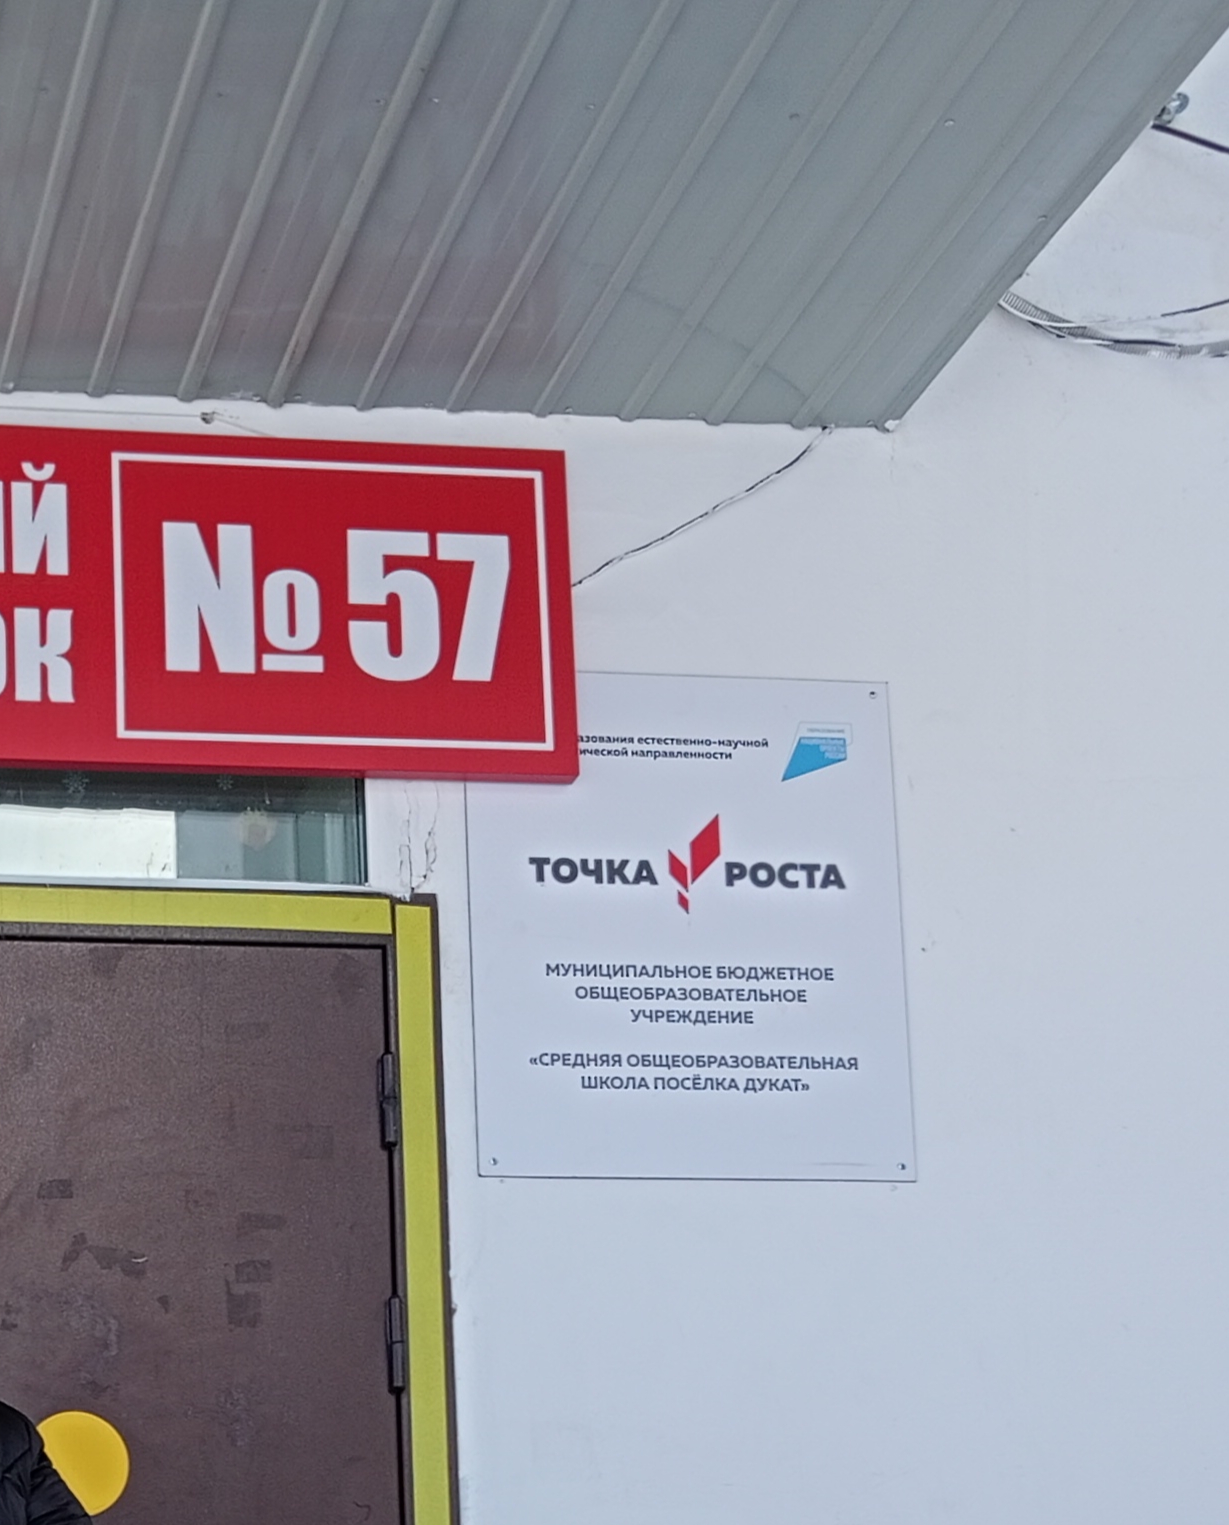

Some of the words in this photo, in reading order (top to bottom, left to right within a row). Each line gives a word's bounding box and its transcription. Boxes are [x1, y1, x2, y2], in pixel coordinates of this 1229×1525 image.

[162, 520, 324, 675] №
[348, 528, 510, 683] 57
[577, 734, 635, 745] азования
[637, 736, 769, 750] естественно-научной
[579, 747, 628, 757] ической
[631, 749, 732, 760] направленности
[528, 856, 658, 886] ТОЧКА
[724, 861, 846, 889] РОСТА
[545, 962, 713, 981] МУНИЦИПАЛЬНОЕ
[716, 965, 834, 983] БЮДЖЕТНОЕ
[574, 985, 807, 1004] ОБЩЕОБРАЗОВАТЕЛЬНОЕ
[630, 1009, 754, 1026] УЧРЕЖДЕНИЕ
[529, 1052, 623, 1070] «СРЕДНЯЯ
[626, 1053, 859, 1072] ОБЩЕОБРАЗОВАТЕЛЬНАЯ
[580, 1075, 650, 1092] ШКОЛА
[653, 1073, 739, 1093] ПОСЁЛКА
[743, 1078, 810, 1095] ДУКАТ»
